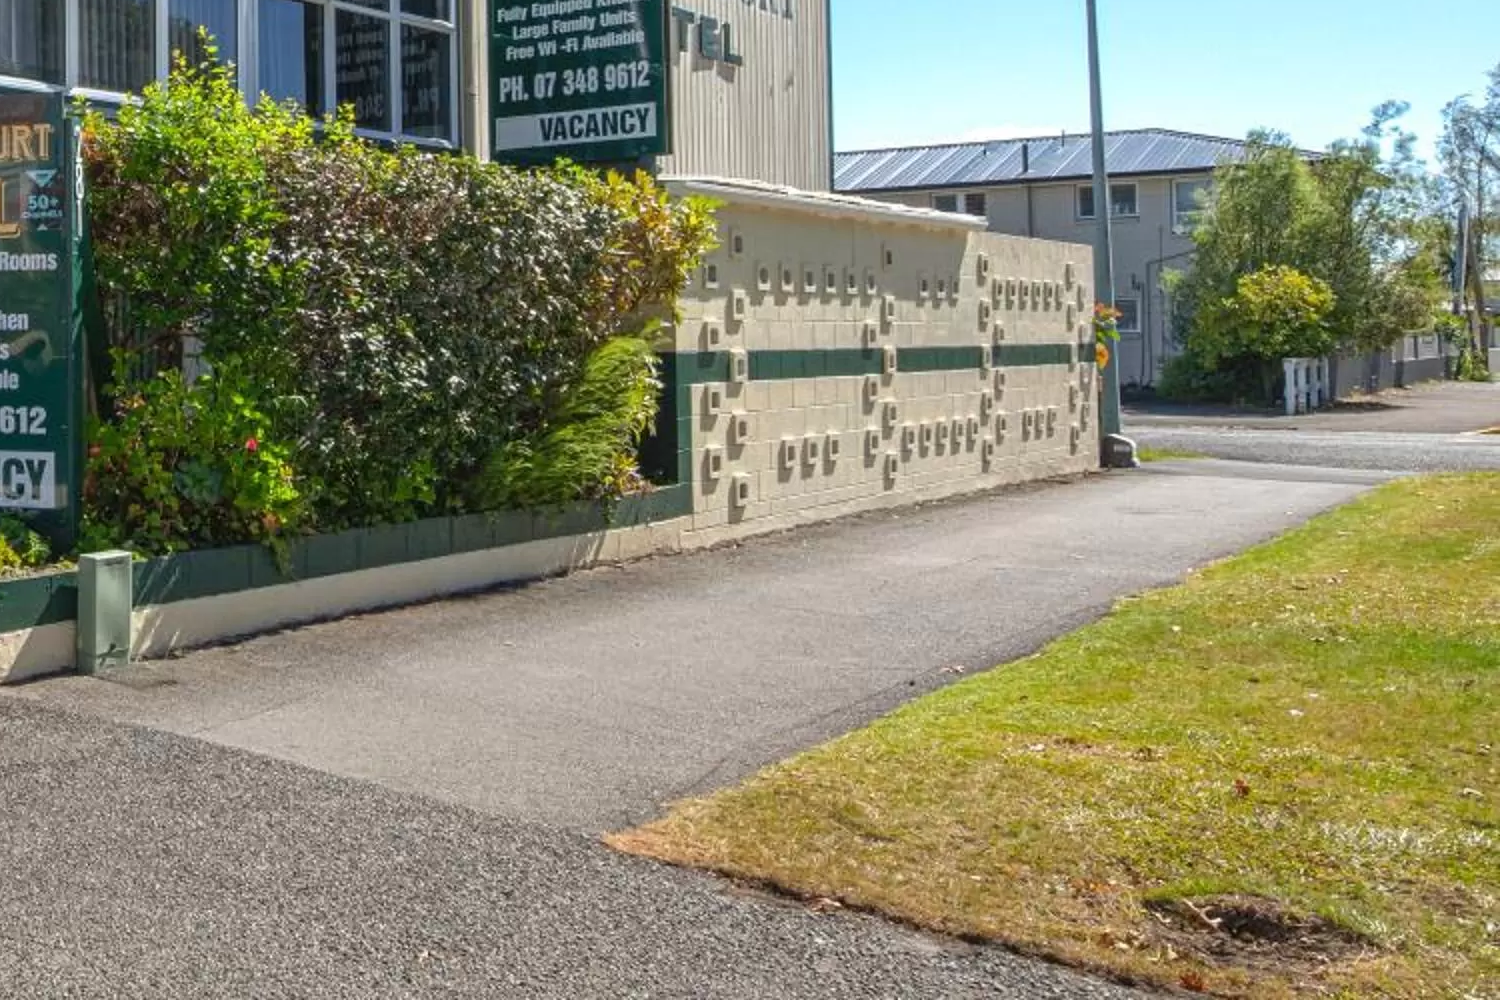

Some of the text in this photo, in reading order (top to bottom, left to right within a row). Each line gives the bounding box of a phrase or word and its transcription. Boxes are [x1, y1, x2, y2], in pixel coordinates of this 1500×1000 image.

[497, 6, 528, 23] Fully
[513, 10, 637, 41] Large Family Units
[505, 45, 535, 61] Free
[582, 29, 645, 51] Available
[500, 60, 650, 103] PH. 07 348 9612
[539, 107, 650, 141] VACANCY
